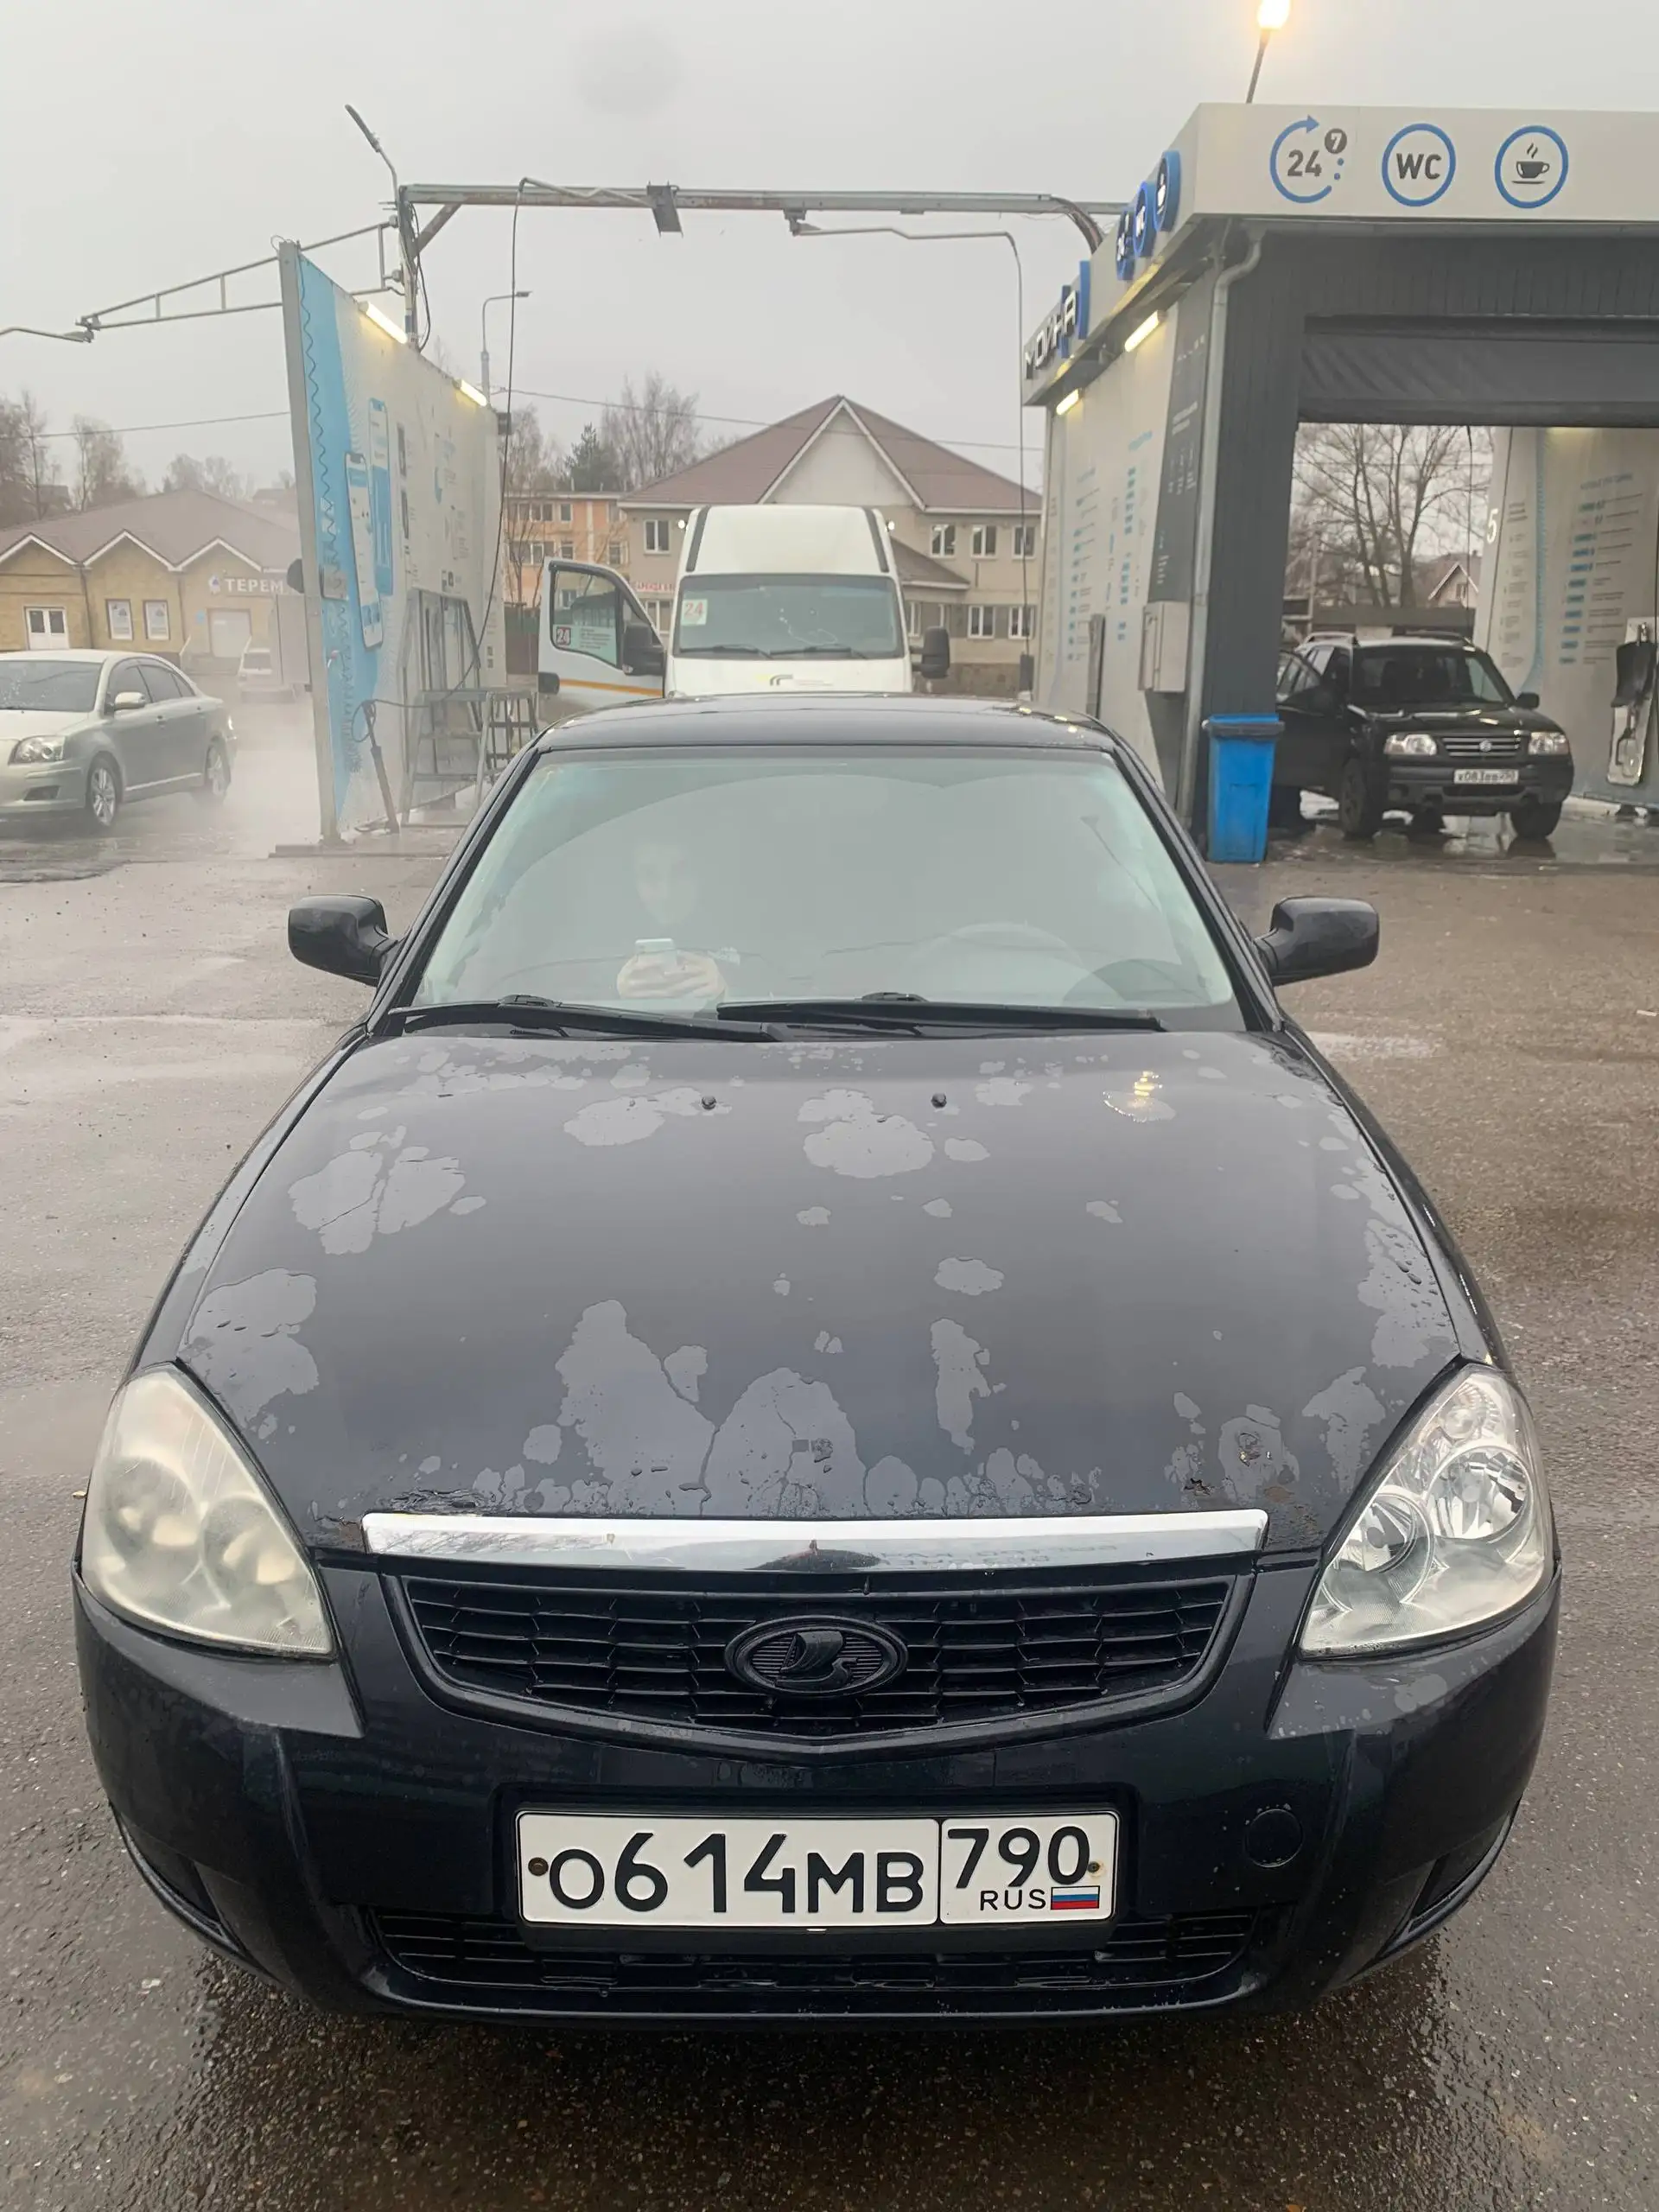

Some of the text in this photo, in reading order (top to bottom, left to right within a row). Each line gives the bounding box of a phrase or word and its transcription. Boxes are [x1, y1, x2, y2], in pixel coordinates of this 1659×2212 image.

[1287, 149, 1323, 177] 24
[1395, 152, 1443, 180] WC
[1486, 508, 1499, 544] 5
[685, 601, 703, 617] 24
[946, 1826, 1090, 1889] 790
[979, 1889, 1046, 1911] RUS
